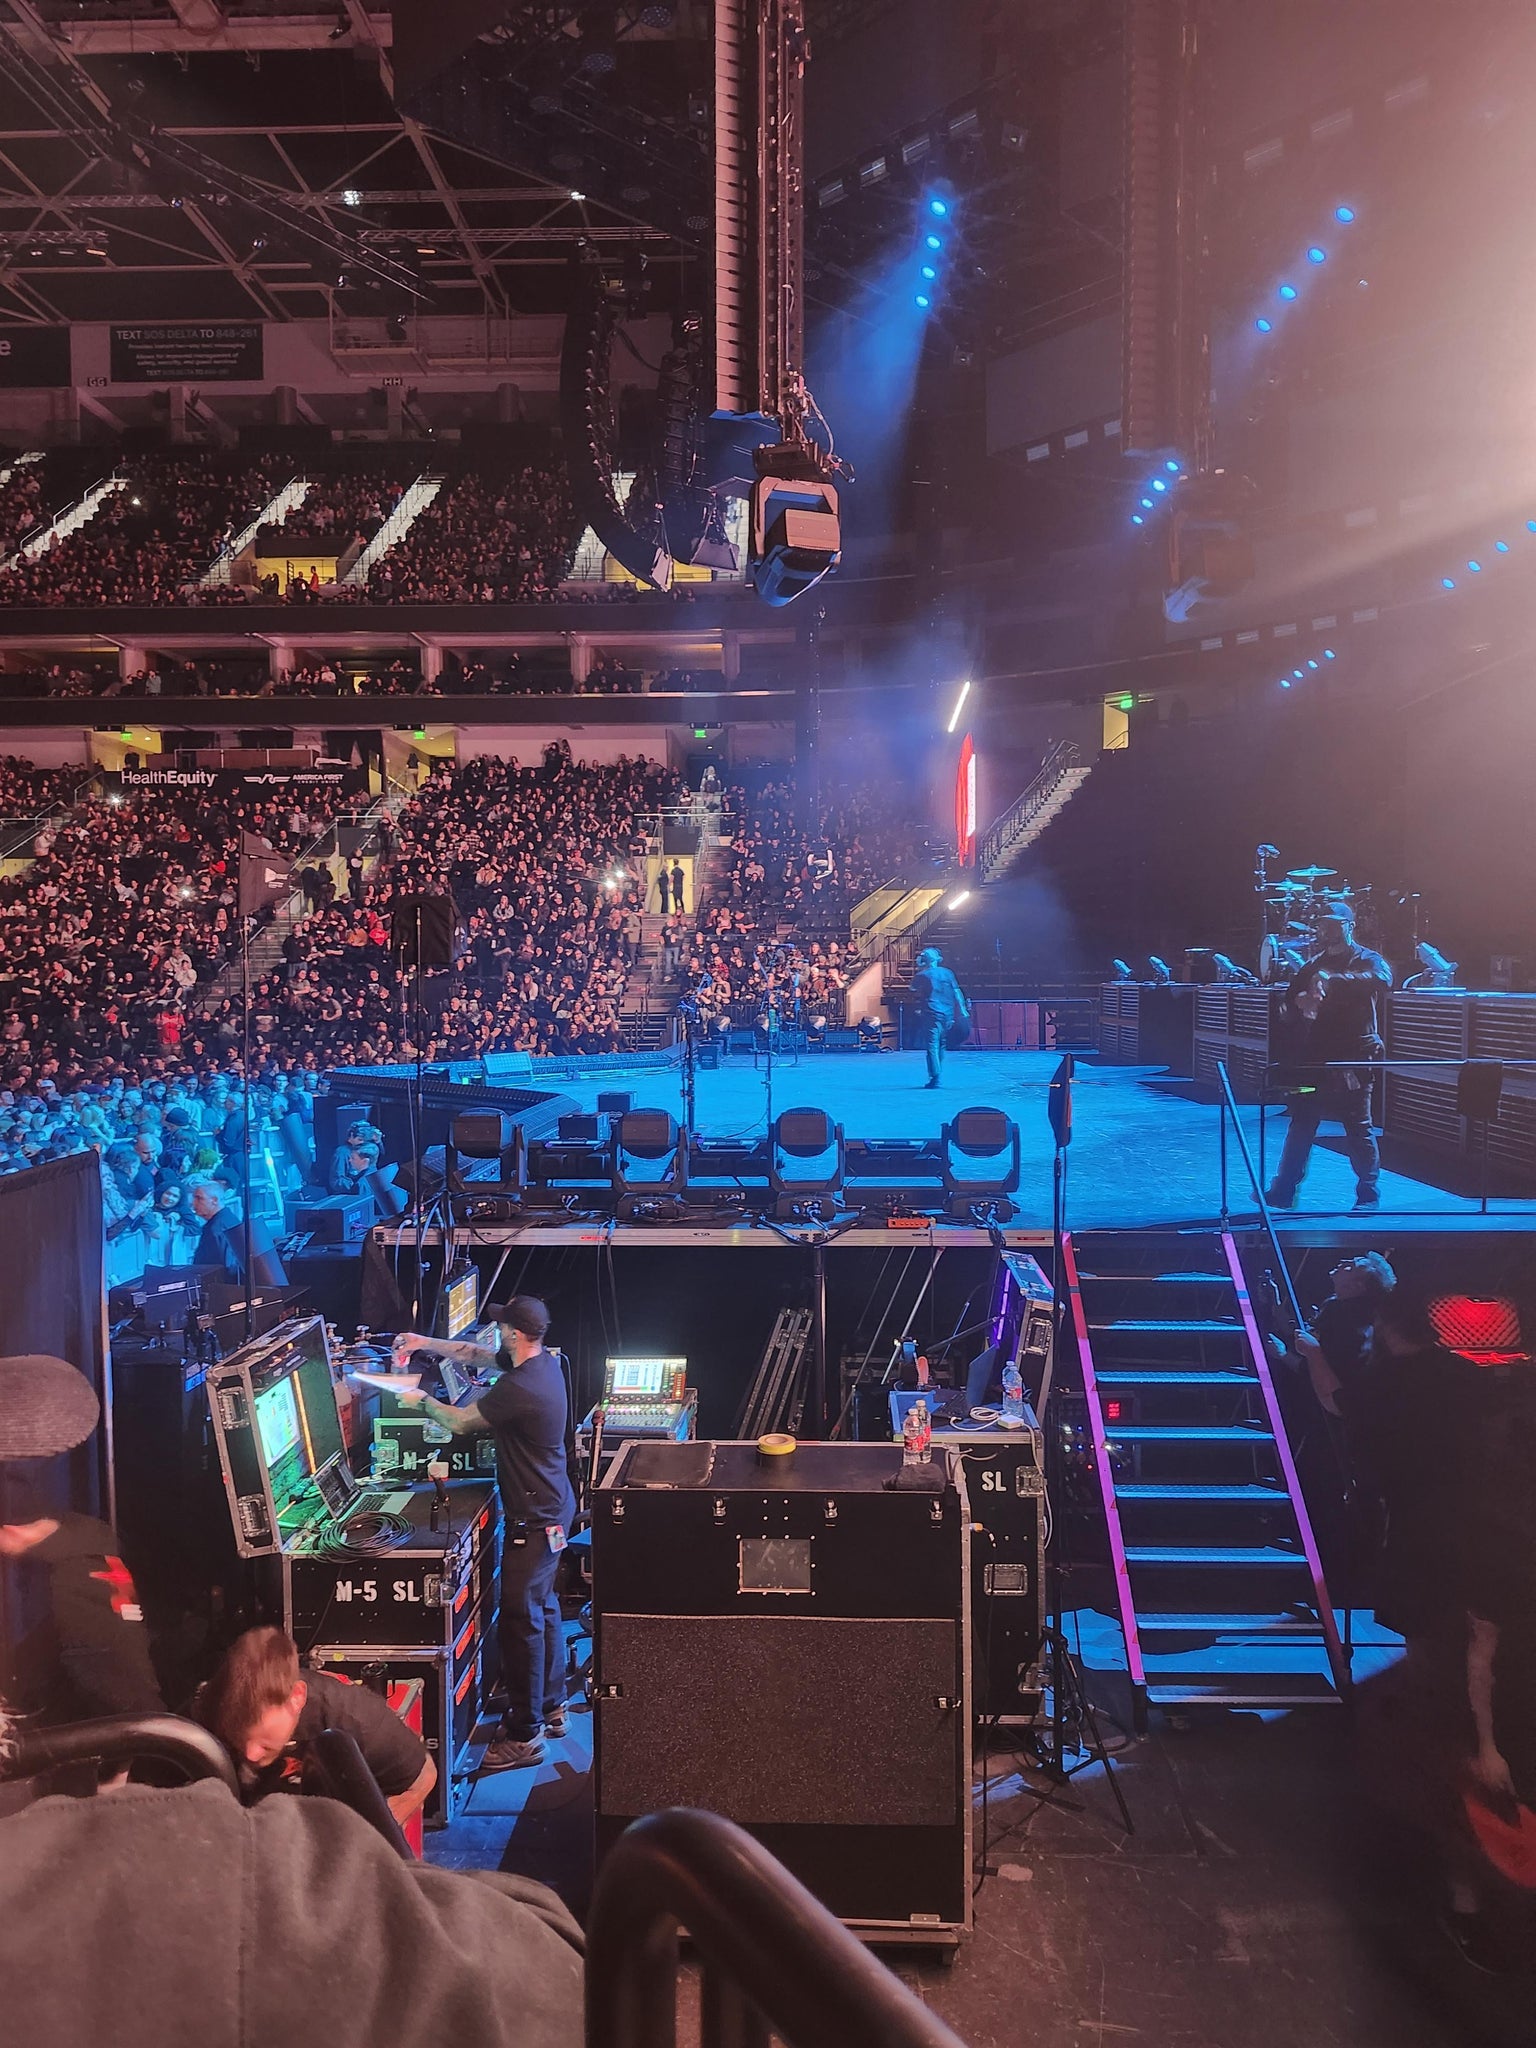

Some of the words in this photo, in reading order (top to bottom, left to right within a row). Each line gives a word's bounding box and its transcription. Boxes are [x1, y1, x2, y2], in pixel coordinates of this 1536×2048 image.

[116, 330, 143, 340] TEXT
[167, 329, 198, 339] DELTA
[200, 329, 214, 338] TO
[121, 770, 215, 787] HealthEquity
[452, 1452, 475, 1470] SL
[981, 1471, 1007, 1492] SL
[336, 1580, 378, 1602] M-5
[392, 1580, 420, 1602] SL
